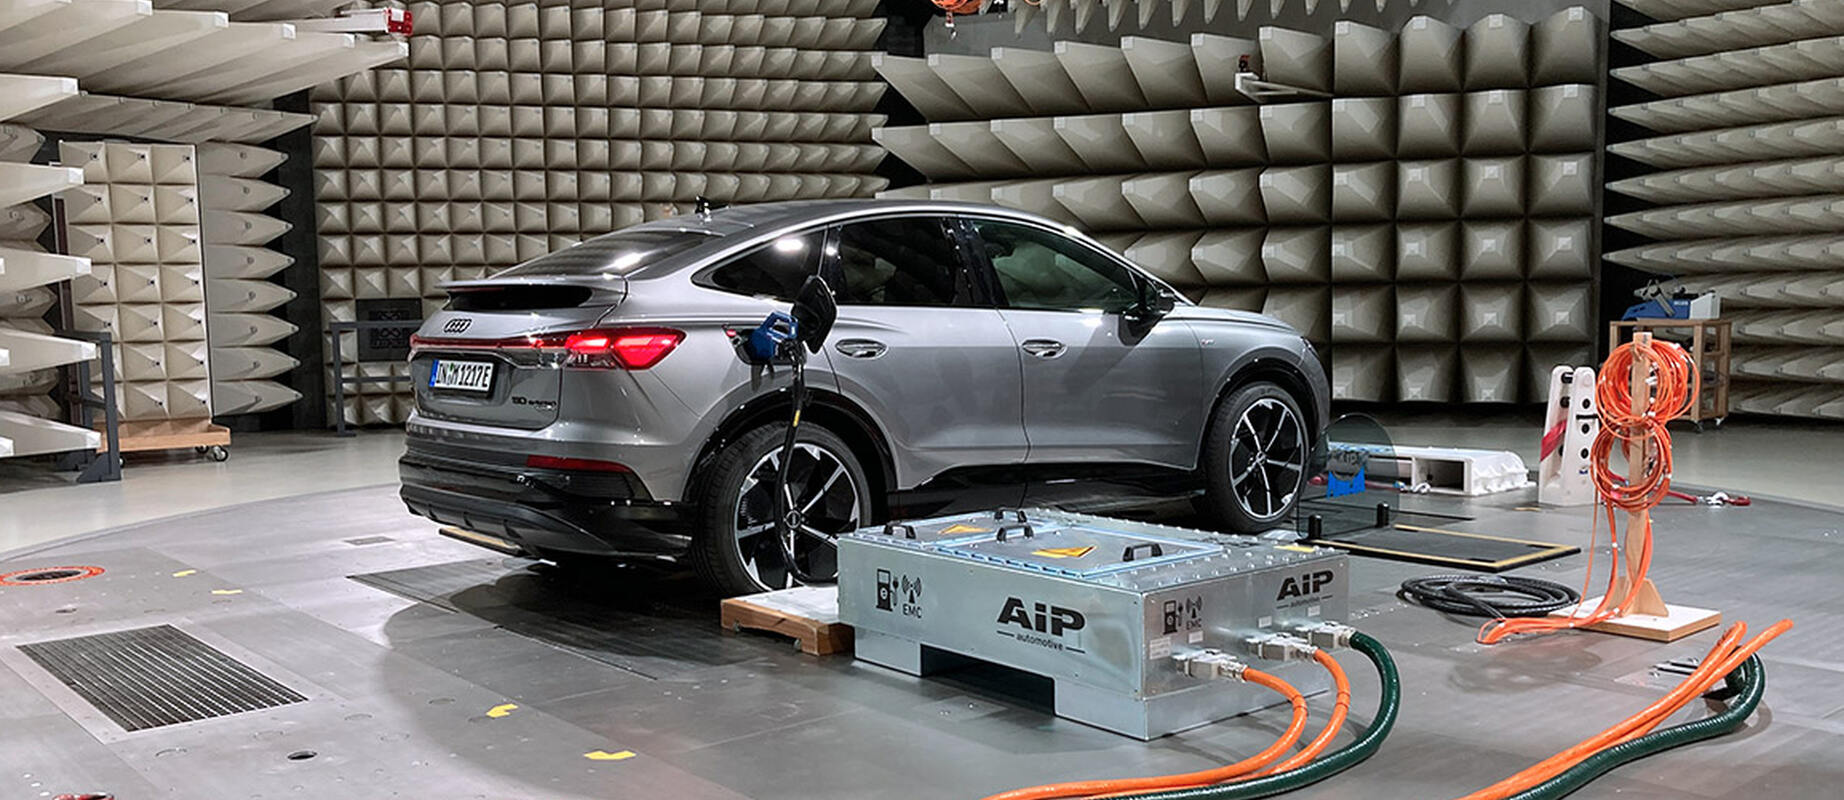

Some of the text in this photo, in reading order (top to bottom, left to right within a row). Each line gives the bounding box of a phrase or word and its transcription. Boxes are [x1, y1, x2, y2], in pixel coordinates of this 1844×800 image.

[903, 603, 921, 618] EMC
[1186, 617, 1202, 630] EMC
[1016, 633, 1063, 651] automotive
